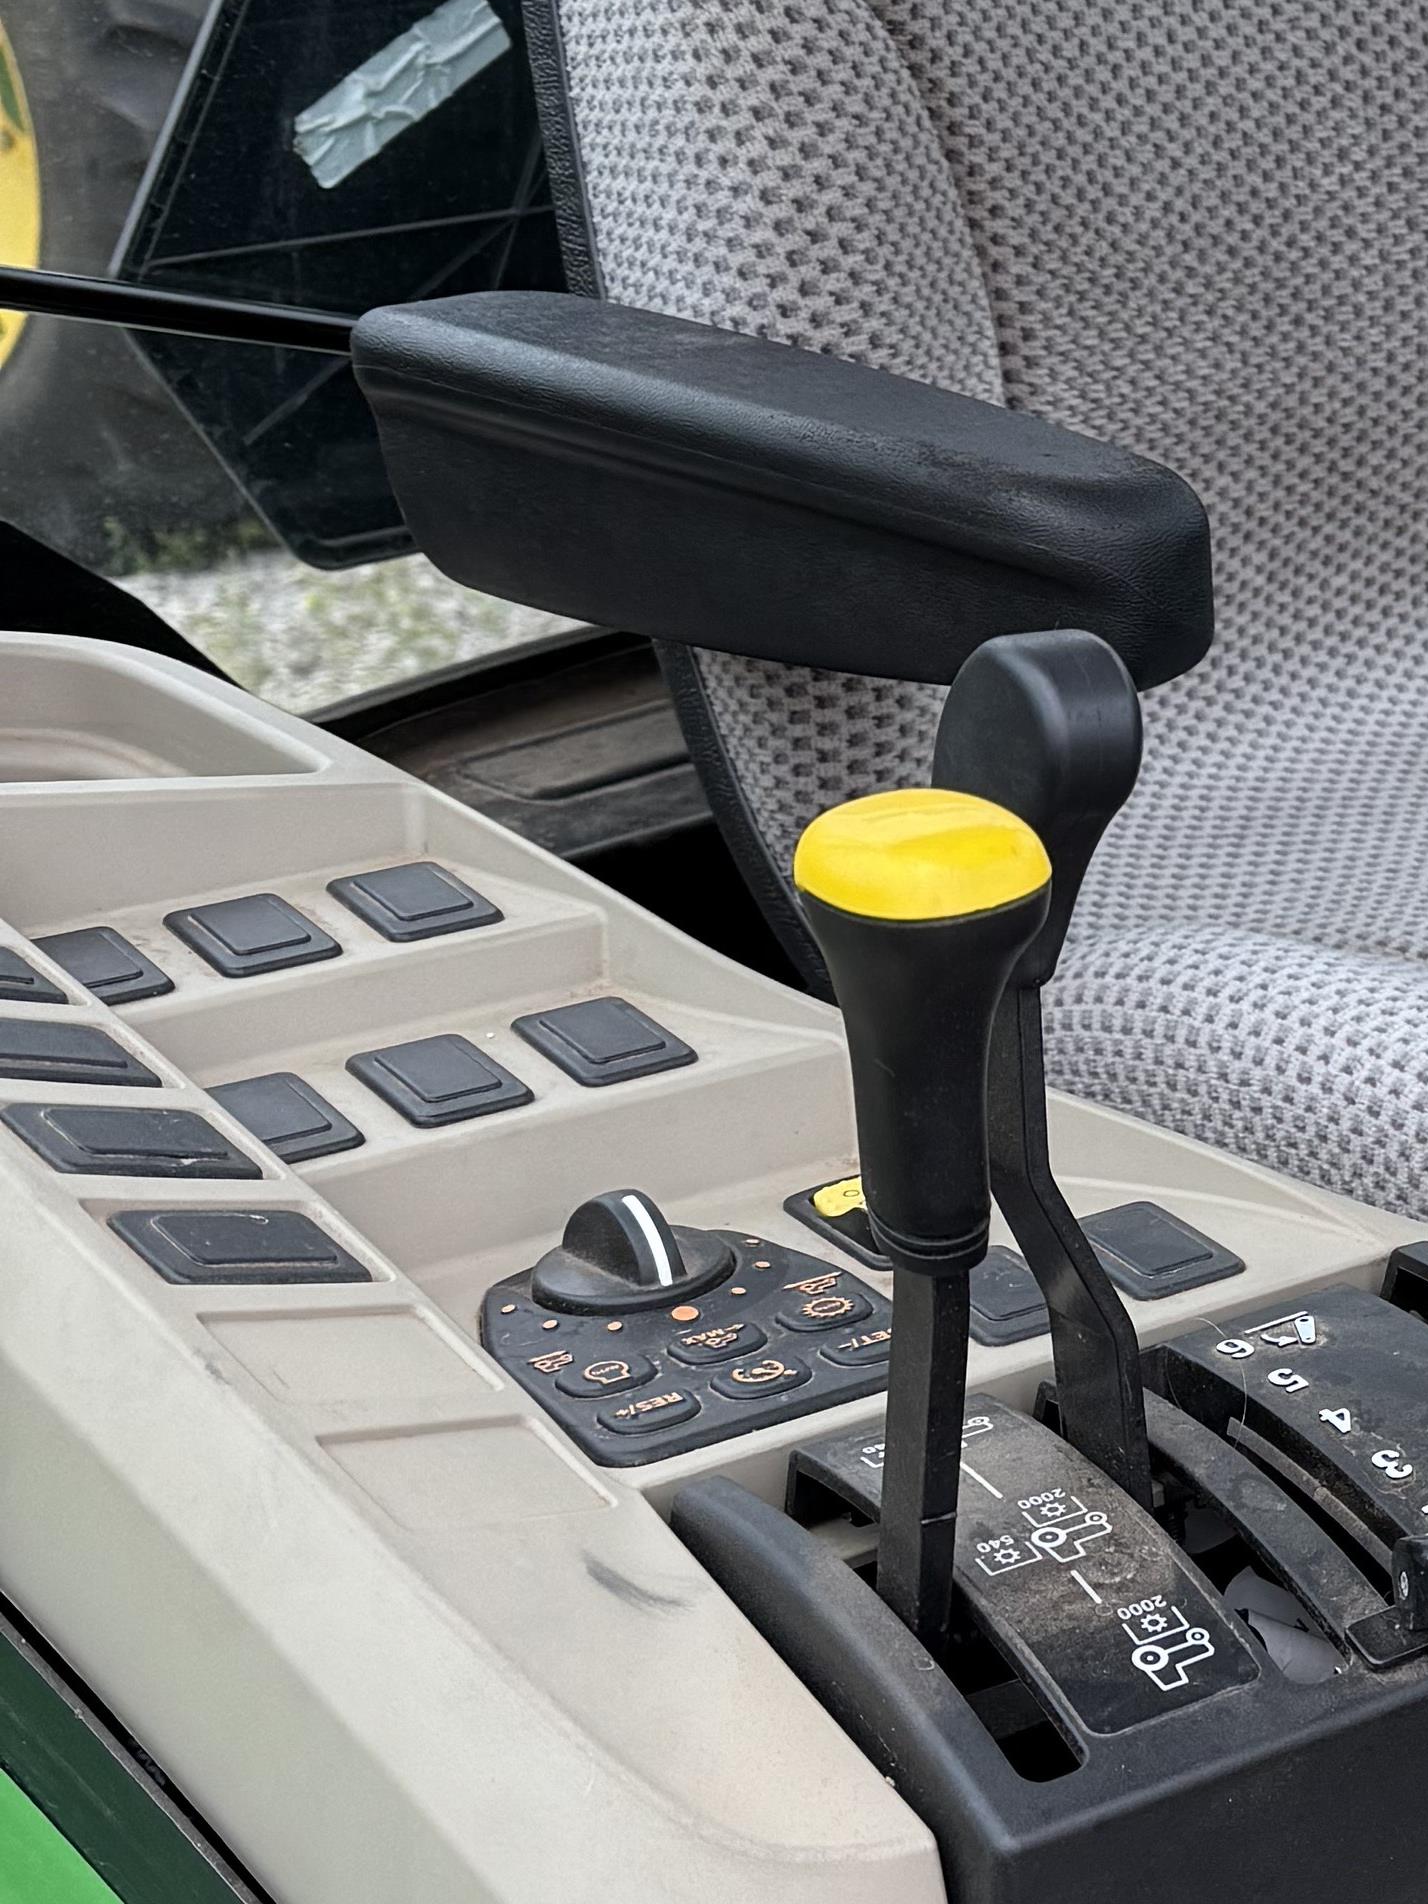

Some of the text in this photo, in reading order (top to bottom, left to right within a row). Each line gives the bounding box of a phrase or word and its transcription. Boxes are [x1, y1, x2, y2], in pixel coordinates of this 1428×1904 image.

[838, 1327, 892, 1351] ET/-
[1267, 1368, 1310, 1393] 5
[1318, 1407, 1353, 1434] 4
[1371, 1449, 1413, 1480] 3
[1017, 1487, 1066, 1510] 2000
[975, 1533, 1015, 1554] 540
[1116, 1594, 1167, 1620] 2000
